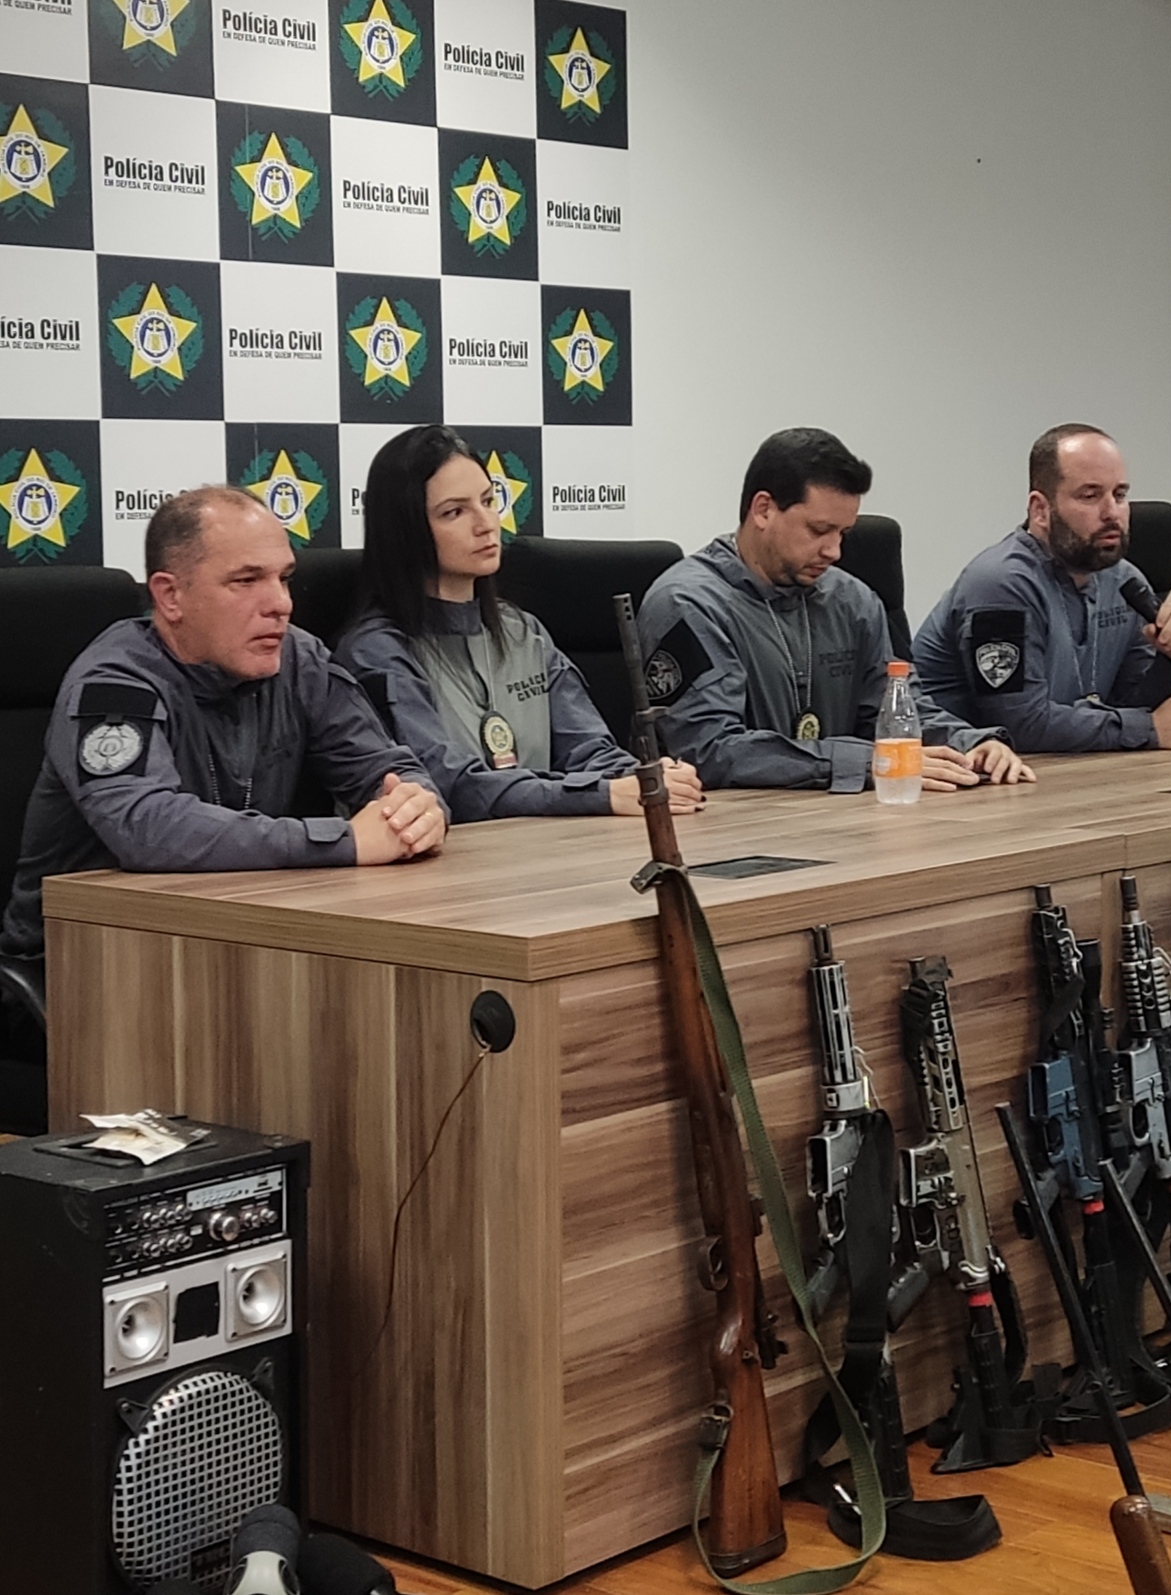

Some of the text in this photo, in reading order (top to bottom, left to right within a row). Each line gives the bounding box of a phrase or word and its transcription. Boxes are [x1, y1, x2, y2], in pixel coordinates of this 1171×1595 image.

[222, 9, 316, 42] Polícia Civil
[444, 42, 525, 73] Polícia Civil
[104, 155, 205, 185] Polícia Civil
[343, 179, 429, 207] Polícia Civil
[547, 200, 621, 225] Polícia Civil
[0, 315, 80, 341] ícia Civil
[229, 328, 322, 351] Polícia Civil
[449, 338, 528, 359] Polícia Civil
[552, 484, 626, 503] Polícia Civil
[506, 672, 546, 695] POLICI
[517, 684, 548, 702] CIVIL
